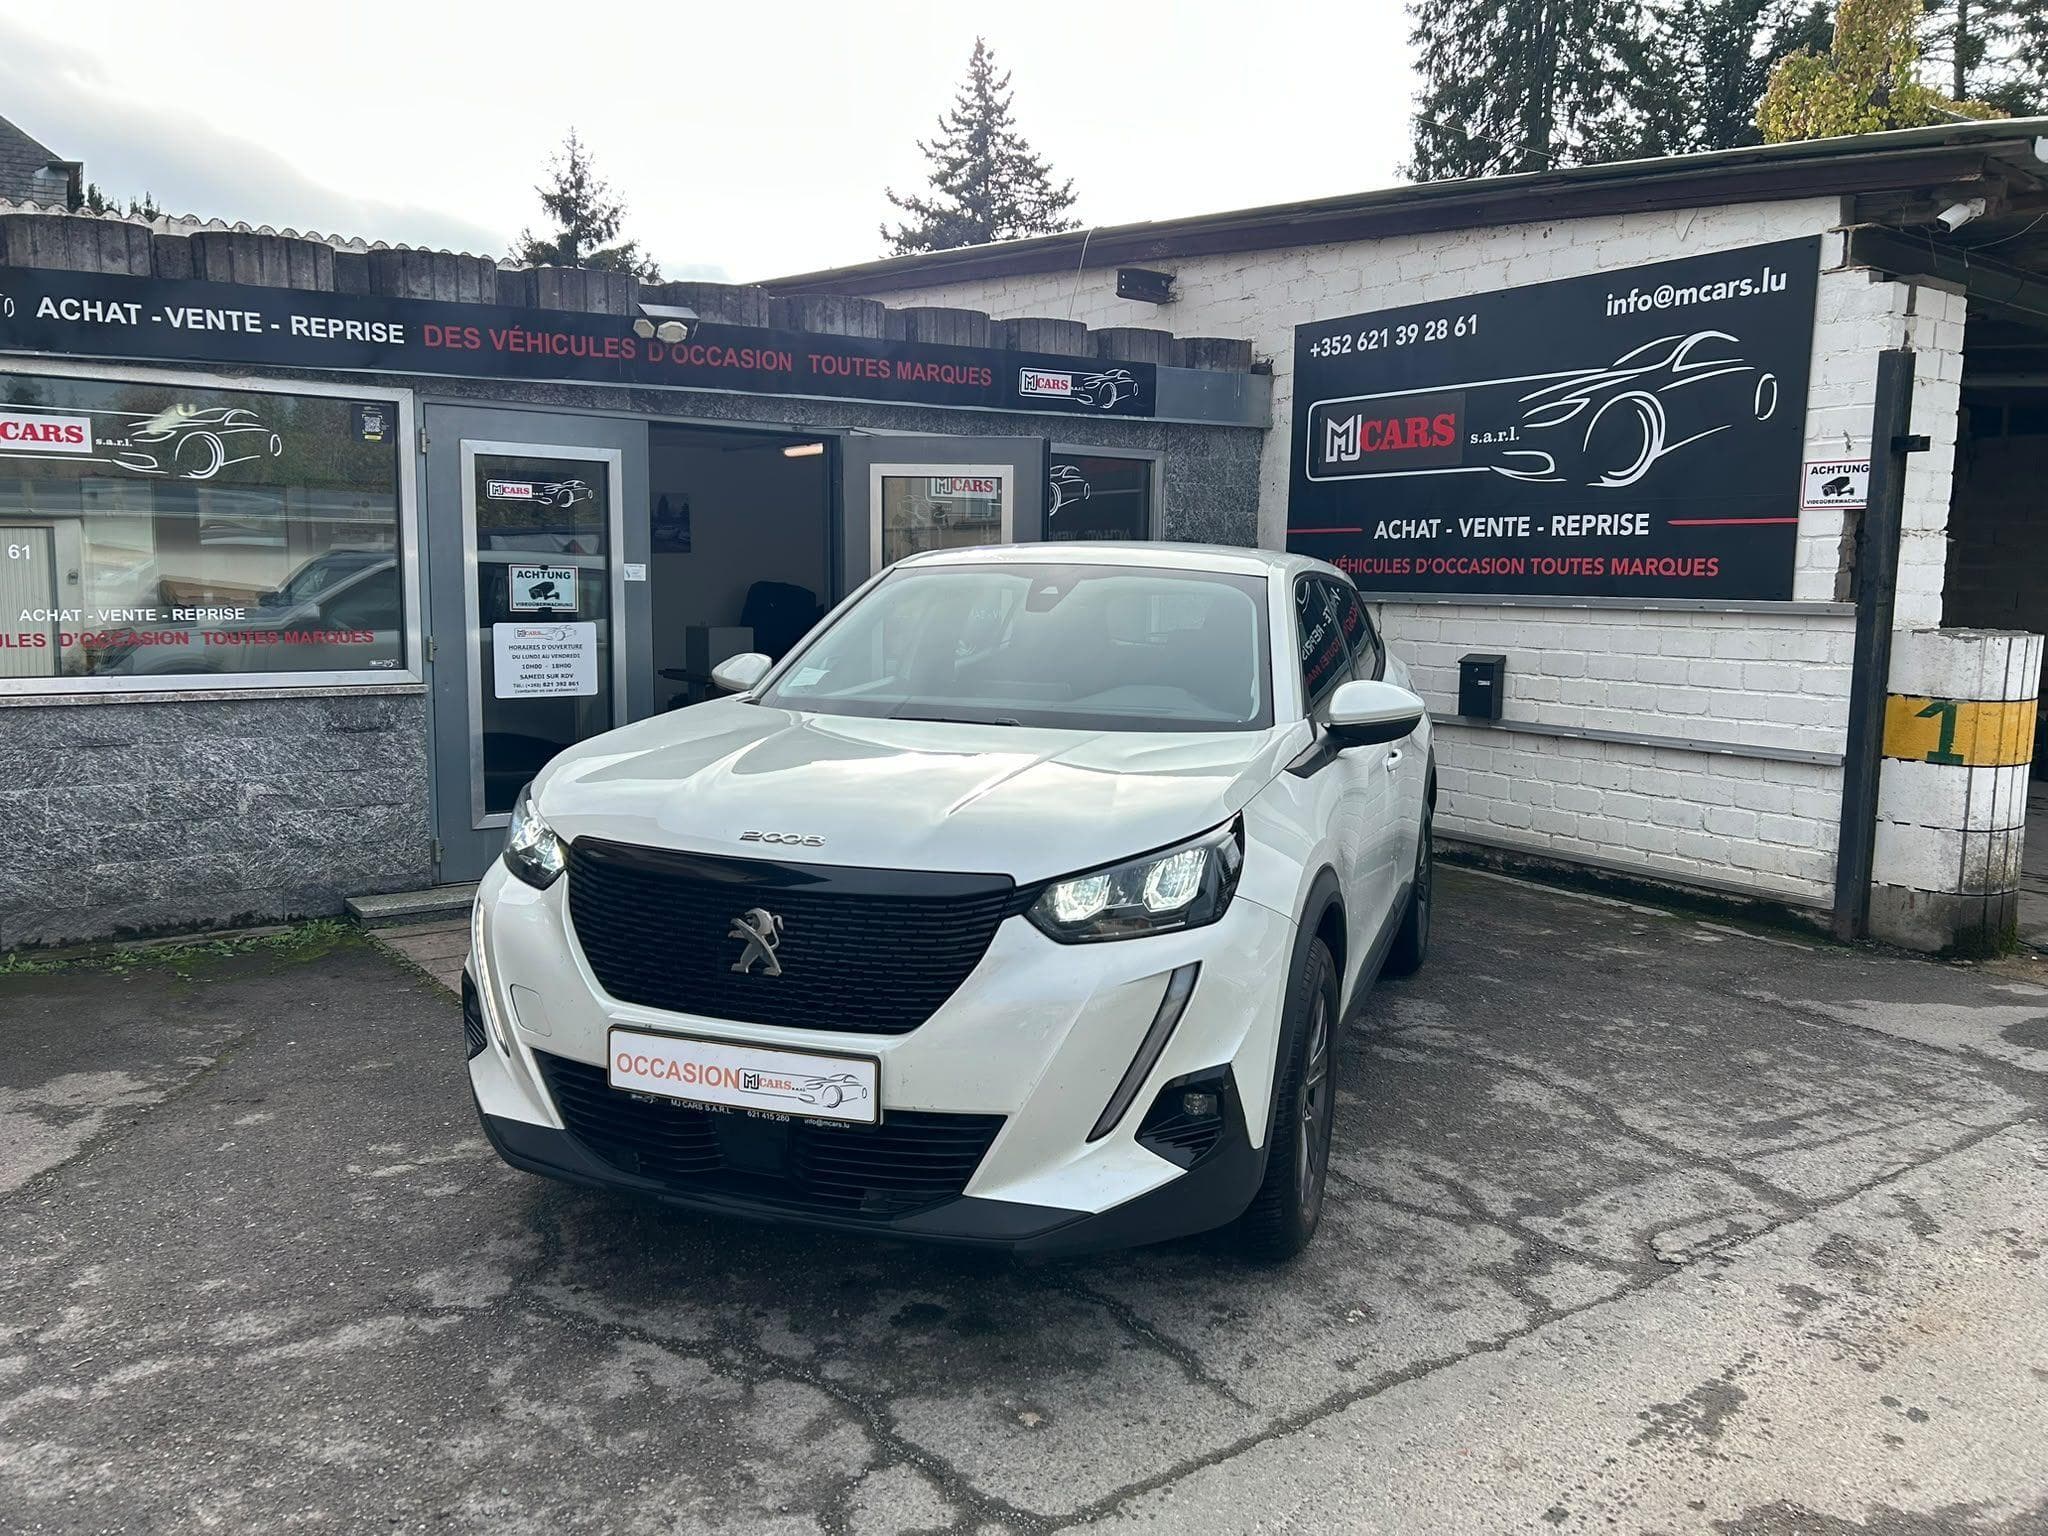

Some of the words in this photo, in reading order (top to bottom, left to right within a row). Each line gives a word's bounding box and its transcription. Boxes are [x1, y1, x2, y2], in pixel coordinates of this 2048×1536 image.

[1606, 266, 1788, 317] info@mcars.lu
[36, 297, 142, 326] ACHAT
[291, 315, 405, 345] REPRISE
[423, 324, 481, 350] DES
[489, 325, 636, 360] VÉHICULES
[808, 354, 890, 379] TOUTES
[897, 361, 992, 387] MARQUES
[1309, 334, 1352, 358] +352
[1357, 328, 1389, 350] 621
[1396, 324, 1420, 346] 39
[1423, 319, 1448, 342] 28
[1454, 314, 1479, 338] 61
[0, 422, 84, 444] CARS
[95, 438, 133, 447] s.a.r.l.
[1470, 427, 1520, 444] s.a.r.l.
[1810, 464, 1869, 475] ACHTUNG
[1374, 517, 1441, 540] ACHAT
[1458, 515, 1530, 539] VENTE
[1551, 513, 1650, 537] REPRISE
[8, 545, 30, 560] 61
[516, 571, 571, 580] ACHTUNG
[1415, 557, 1526, 576] D'OCCASION
[1530, 557, 1605, 577] TOUTES
[1611, 557, 1719, 578] MARQUES
[19, 609, 82, 622] ACHAT
[98, 609, 157, 622] VENTE
[172, 607, 246, 621] REPRISE
[60, 631, 190, 648] D'OCCASION
[204, 630, 280, 646] TOUTES
[284, 629, 374, 644] MARQUES
[1914, 701, 1964, 765] 1
[739, 829, 826, 847] 2008
[616, 1053, 740, 1089] OCCASION
